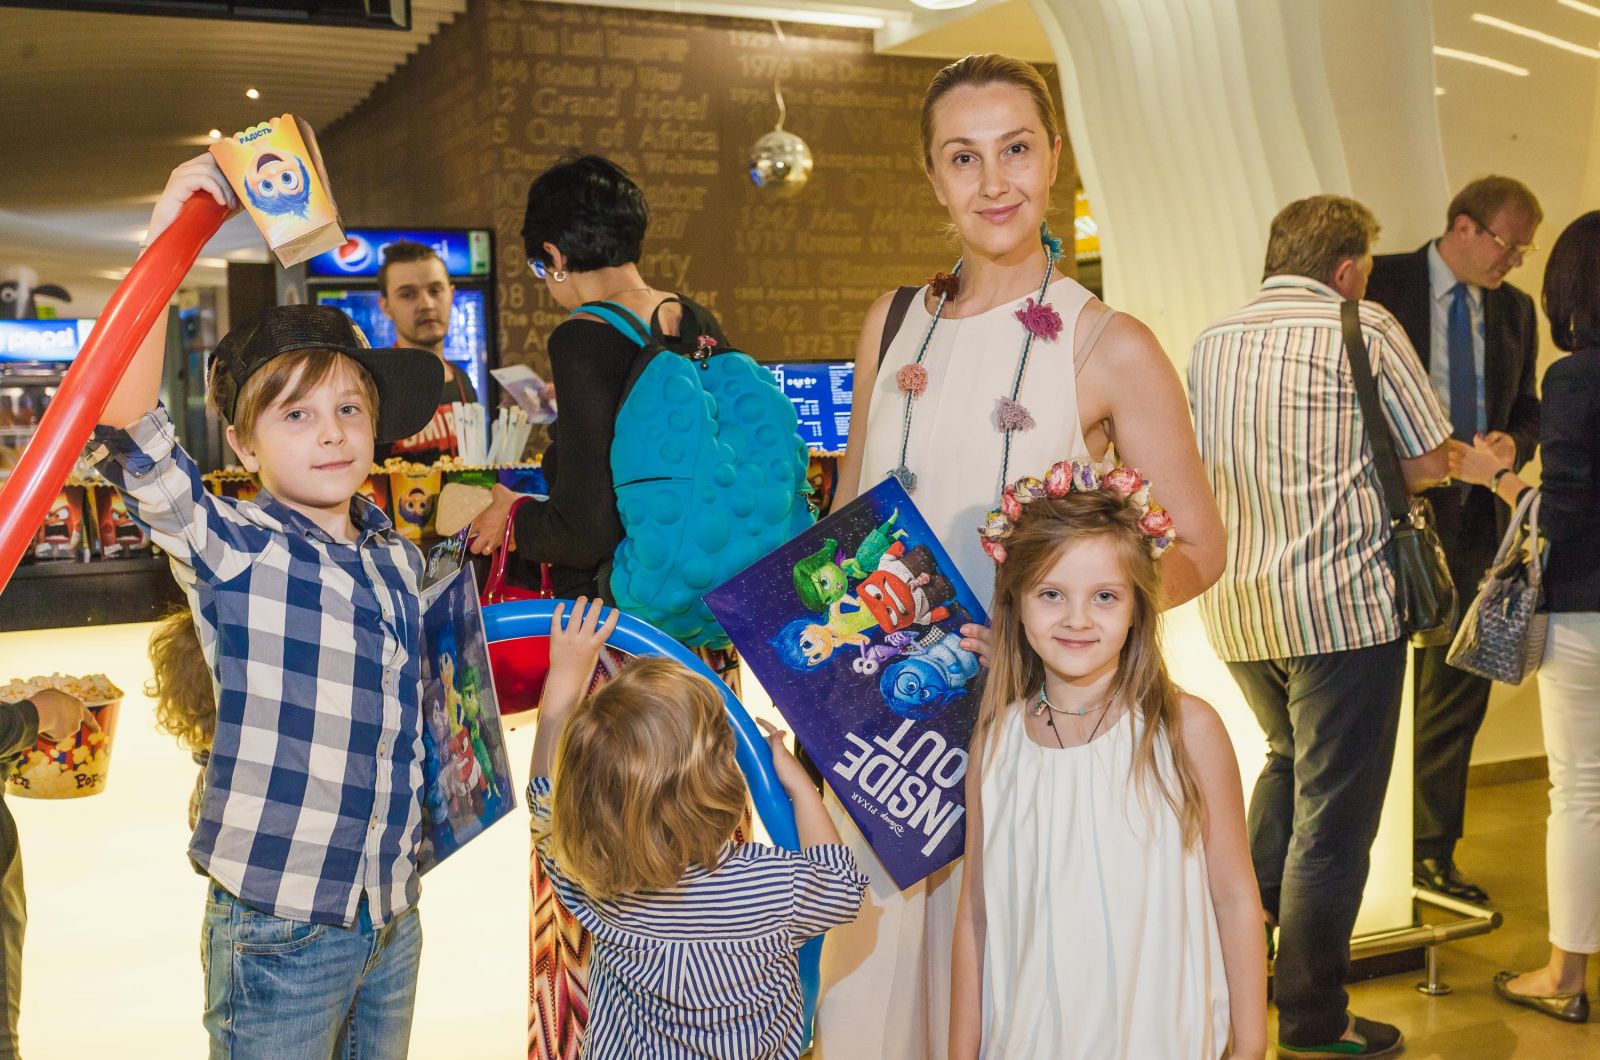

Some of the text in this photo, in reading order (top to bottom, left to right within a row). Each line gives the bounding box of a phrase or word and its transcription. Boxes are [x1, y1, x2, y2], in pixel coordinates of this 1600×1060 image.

[531, 87, 622, 116] Grand
[633, 92, 709, 120] Hotel
[239, 127, 272, 145] РАДІСТЬ
[526, 118, 583, 147] Out
[596, 118, 627, 148] of
[638, 121, 719, 151] Africa
[873, 718, 969, 789] OUT
[833, 731, 966, 857] INSIDE
[851, 791, 879, 815] PIXAR
